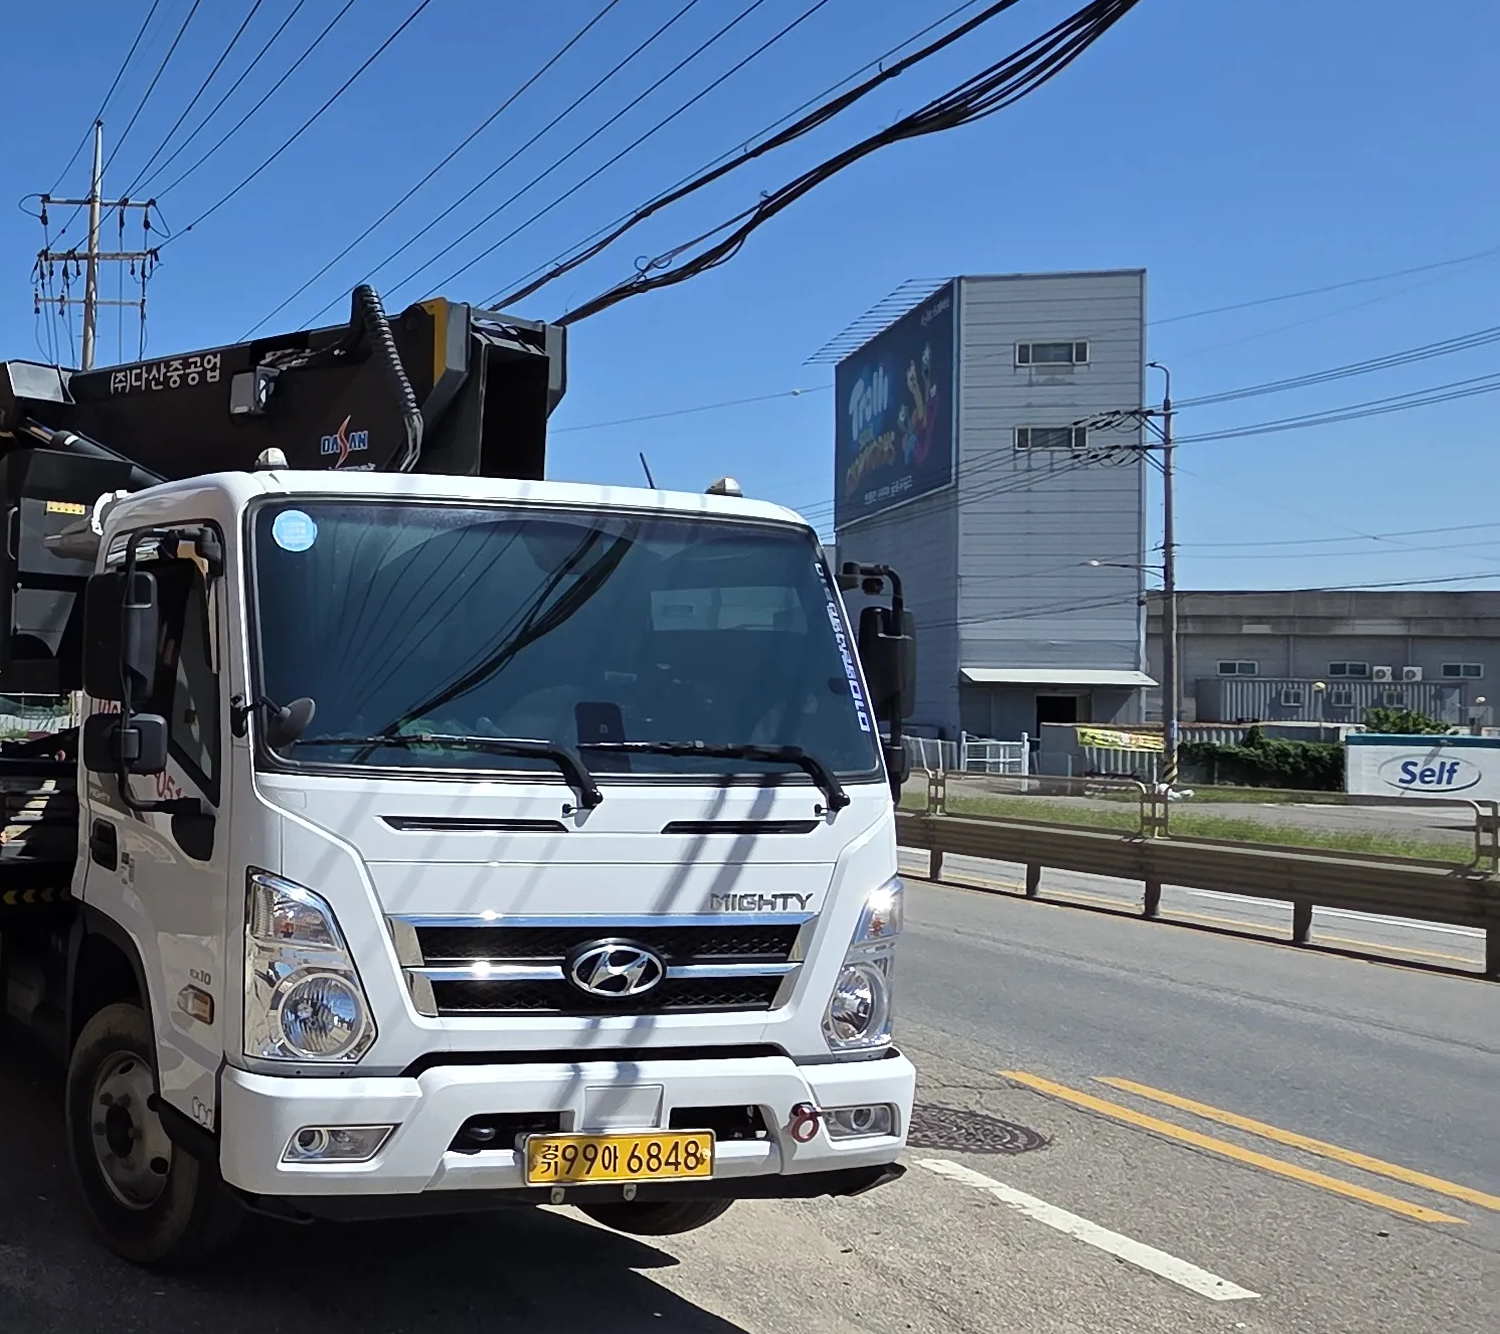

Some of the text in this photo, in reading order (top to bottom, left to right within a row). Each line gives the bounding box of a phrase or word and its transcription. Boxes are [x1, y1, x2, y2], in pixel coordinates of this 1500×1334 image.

[110, 353, 221, 394] (주)다산중공업
[1398, 760, 1460, 785] Self
[709, 893, 814, 911] MIGHTY
[561, 1143, 619, 1175] 99아
[626, 1140, 700, 1173] 6848
